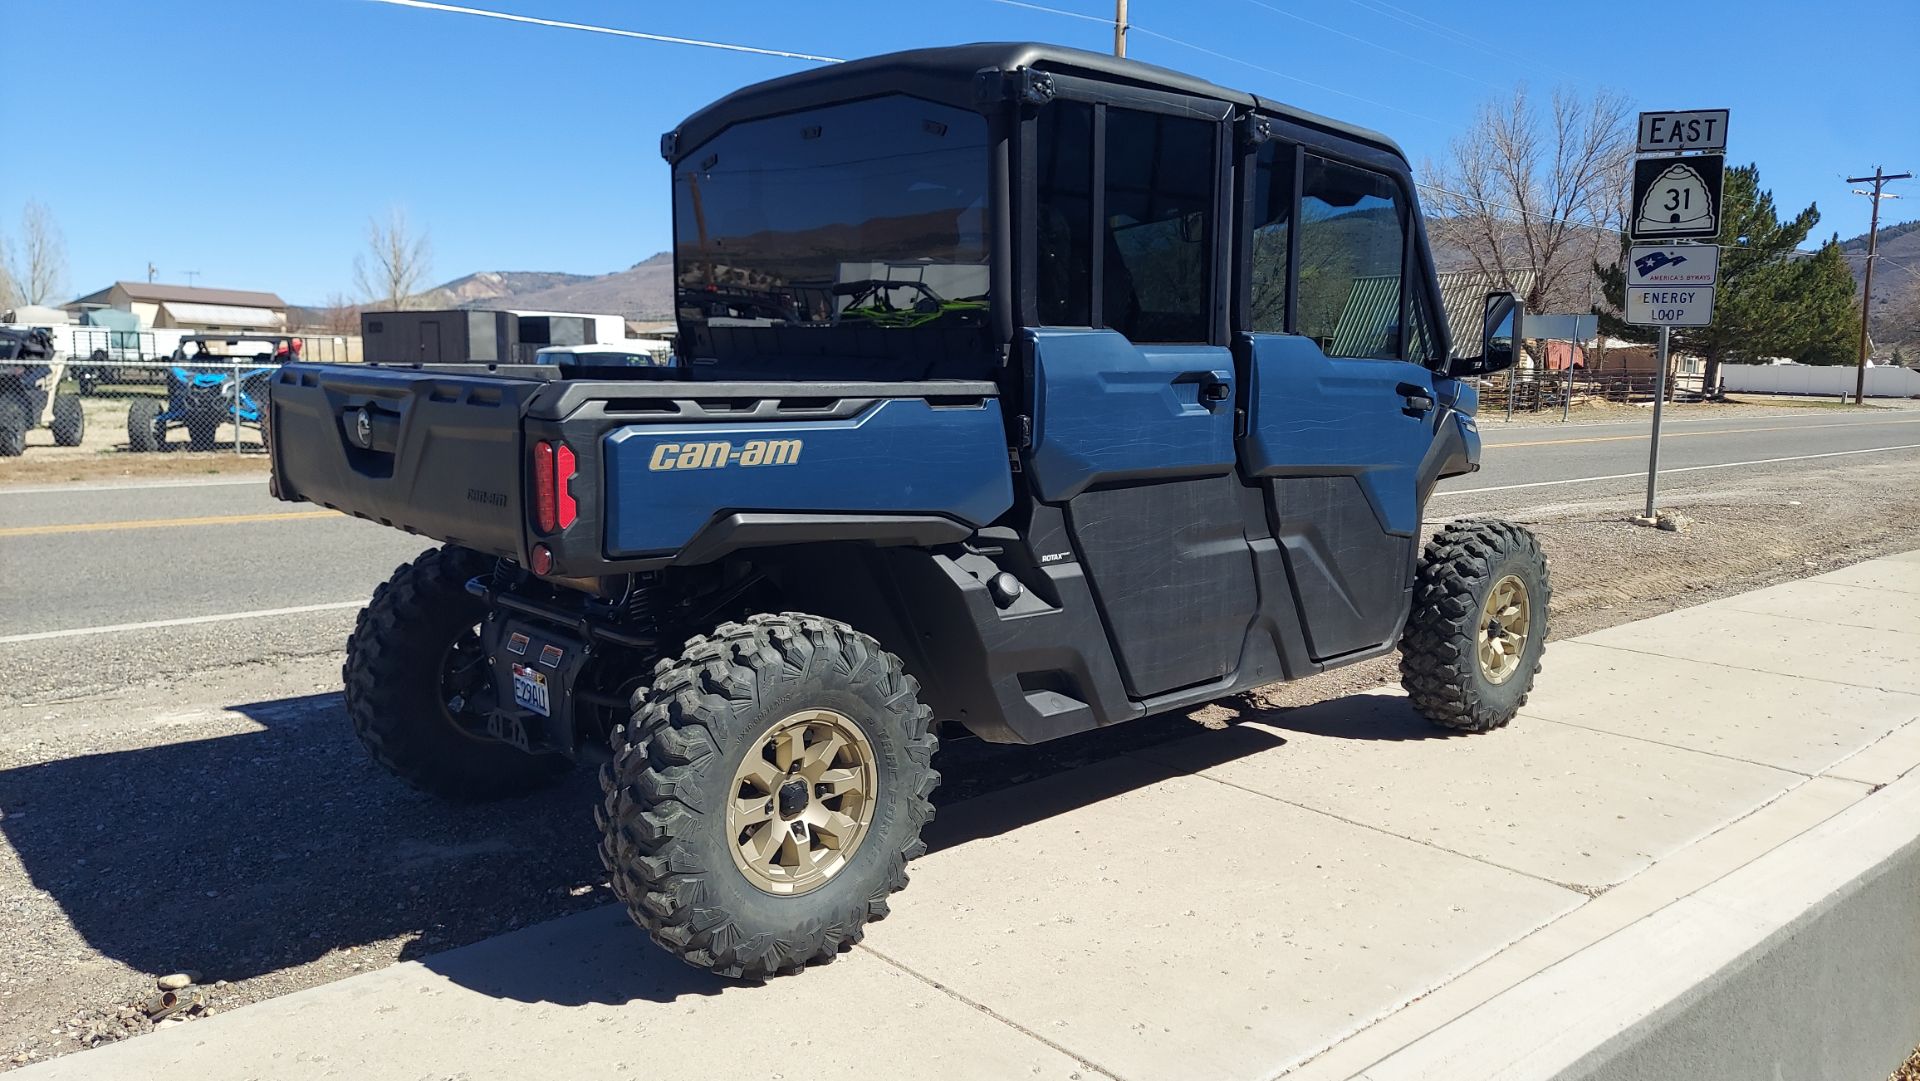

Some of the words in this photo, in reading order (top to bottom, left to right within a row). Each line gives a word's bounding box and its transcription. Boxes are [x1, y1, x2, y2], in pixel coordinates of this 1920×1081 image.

[1650, 118, 1717, 144] EAST
[1663, 188, 1690, 211] 31
[1643, 292, 1695, 304] ENERGY
[1652, 310, 1684, 321] LOOP
[649, 439, 802, 471] can-am
[1042, 553, 1062, 562] ROTAX
